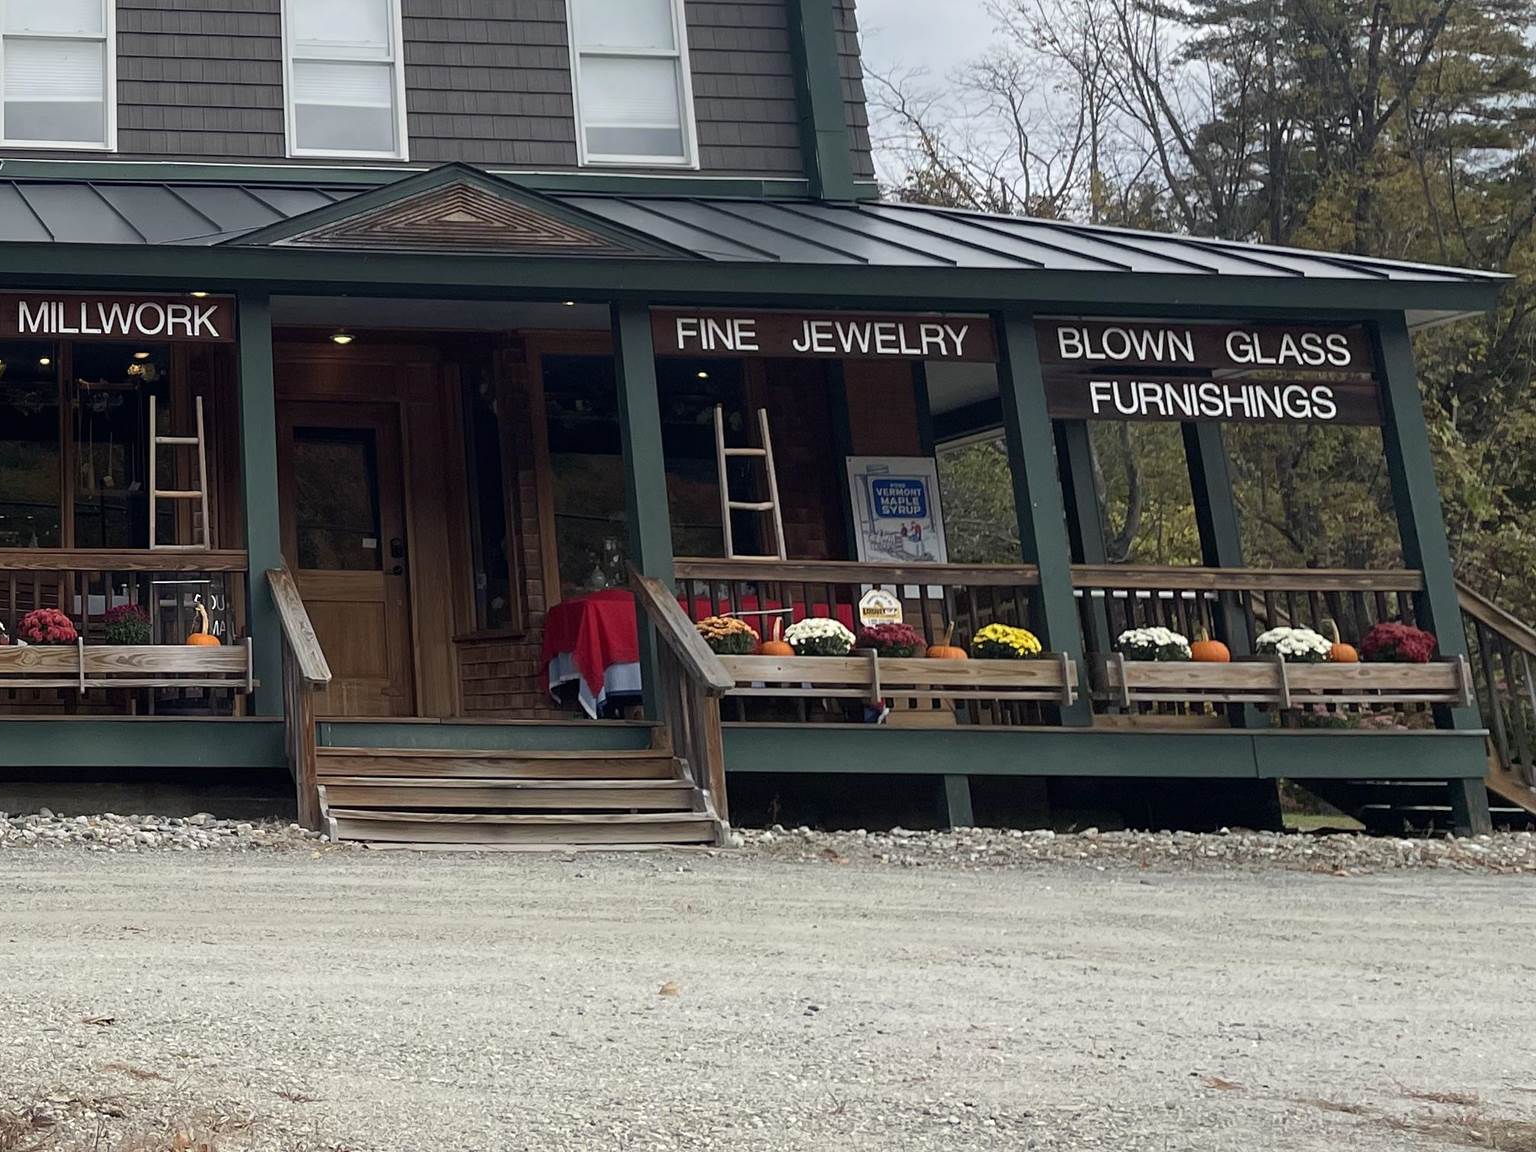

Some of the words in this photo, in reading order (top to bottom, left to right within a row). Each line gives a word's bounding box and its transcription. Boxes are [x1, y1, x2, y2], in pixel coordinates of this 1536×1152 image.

[18, 301, 220, 337] MILLWORK
[676, 318, 759, 351] FINE
[792, 320, 969, 356] JEWELRY
[1057, 328, 1195, 362] BLOWN
[1225, 331, 1351, 366] GLASS
[1089, 381, 1337, 420] FURNISHINGS
[876, 488, 922, 497] VERMONT
[881, 497, 919, 506] MAPLE
[882, 506, 921, 515] SYRUP
